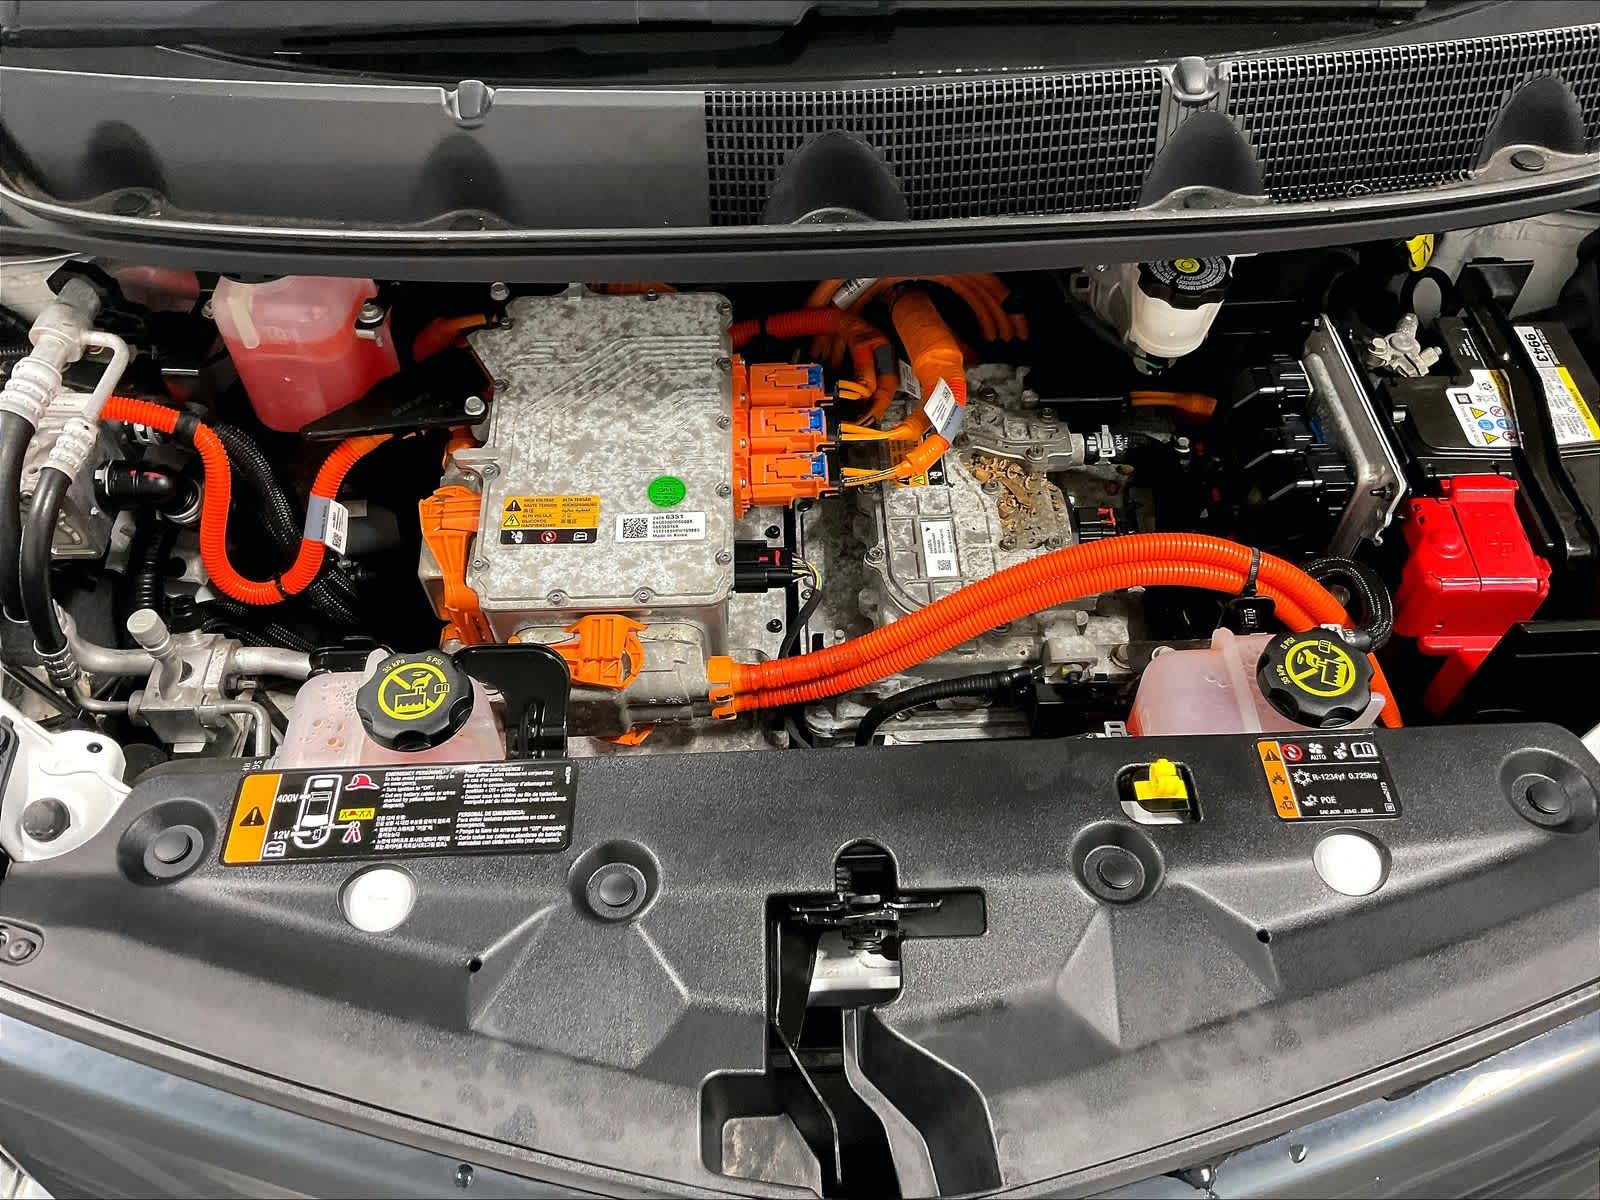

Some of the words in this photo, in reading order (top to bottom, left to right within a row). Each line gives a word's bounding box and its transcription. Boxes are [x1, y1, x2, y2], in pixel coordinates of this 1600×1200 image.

[1524, 334, 1549, 362] 9943
[1311, 773, 1345, 781] R-1234yf
[1348, 772, 1378, 780] 0.725kg
[277, 794, 299, 803] 400V
[1320, 795, 1337, 804] POE
[273, 830, 290, 840] 12V
